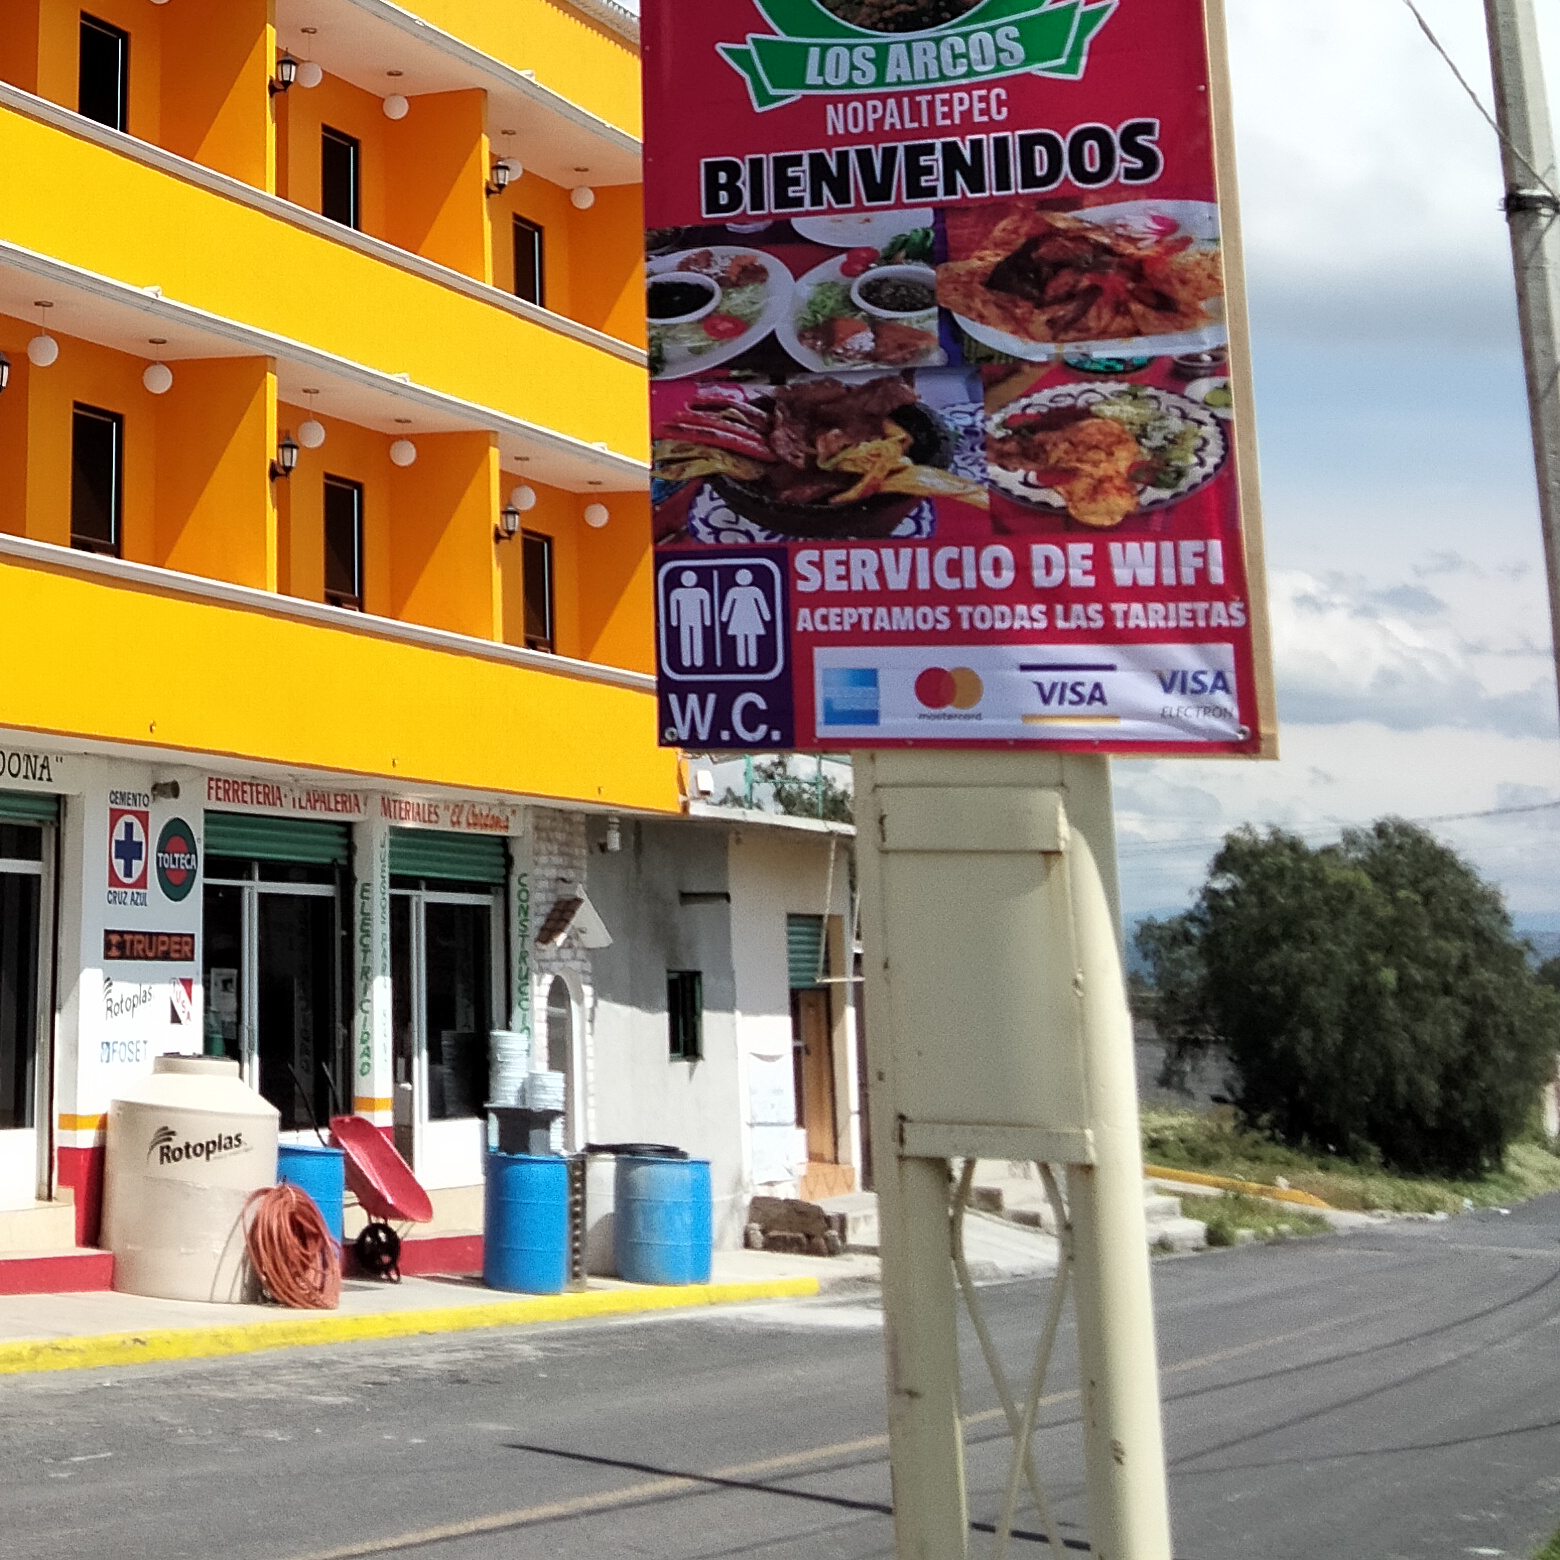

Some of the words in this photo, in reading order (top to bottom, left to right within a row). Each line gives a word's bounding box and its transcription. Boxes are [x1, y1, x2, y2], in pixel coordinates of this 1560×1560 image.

[804, 44, 877, 86] LOS
[885, 25, 1026, 83] ARCOS
[826, 88, 1009, 135] NOPALTEPEC
[701, 119, 1163, 217] BIENVENIDOS
[794, 543, 1017, 592] SERVICIO
[1030, 543, 1097, 590] DE
[1109, 540, 1226, 588] WIFI
[796, 604, 952, 633] ACEPTAMOS
[957, 603, 1048, 631] TODAS
[1056, 603, 1105, 630] LAS
[1111, 600, 1247, 630] TARJETAS
[1034, 680, 1109, 707] VISA
[1154, 669, 1233, 696] VISA
[668, 692, 780, 743] W.C.
[1160, 704, 1236, 721] ELECTRON
[109, 790, 150, 808] CEMENTO
[207, 777, 284, 809] FERRETERIA
[157, 852, 197, 870] TOLTECA
[107, 890, 128, 906] CRUZ
[130, 890, 148, 907] AZUL
[122, 933, 192, 960] TRUPER
[105, 983, 153, 1021] Rotoplas
[111, 1040, 149, 1063] FOSET
[159, 1132, 243, 1165] Rotoplas
